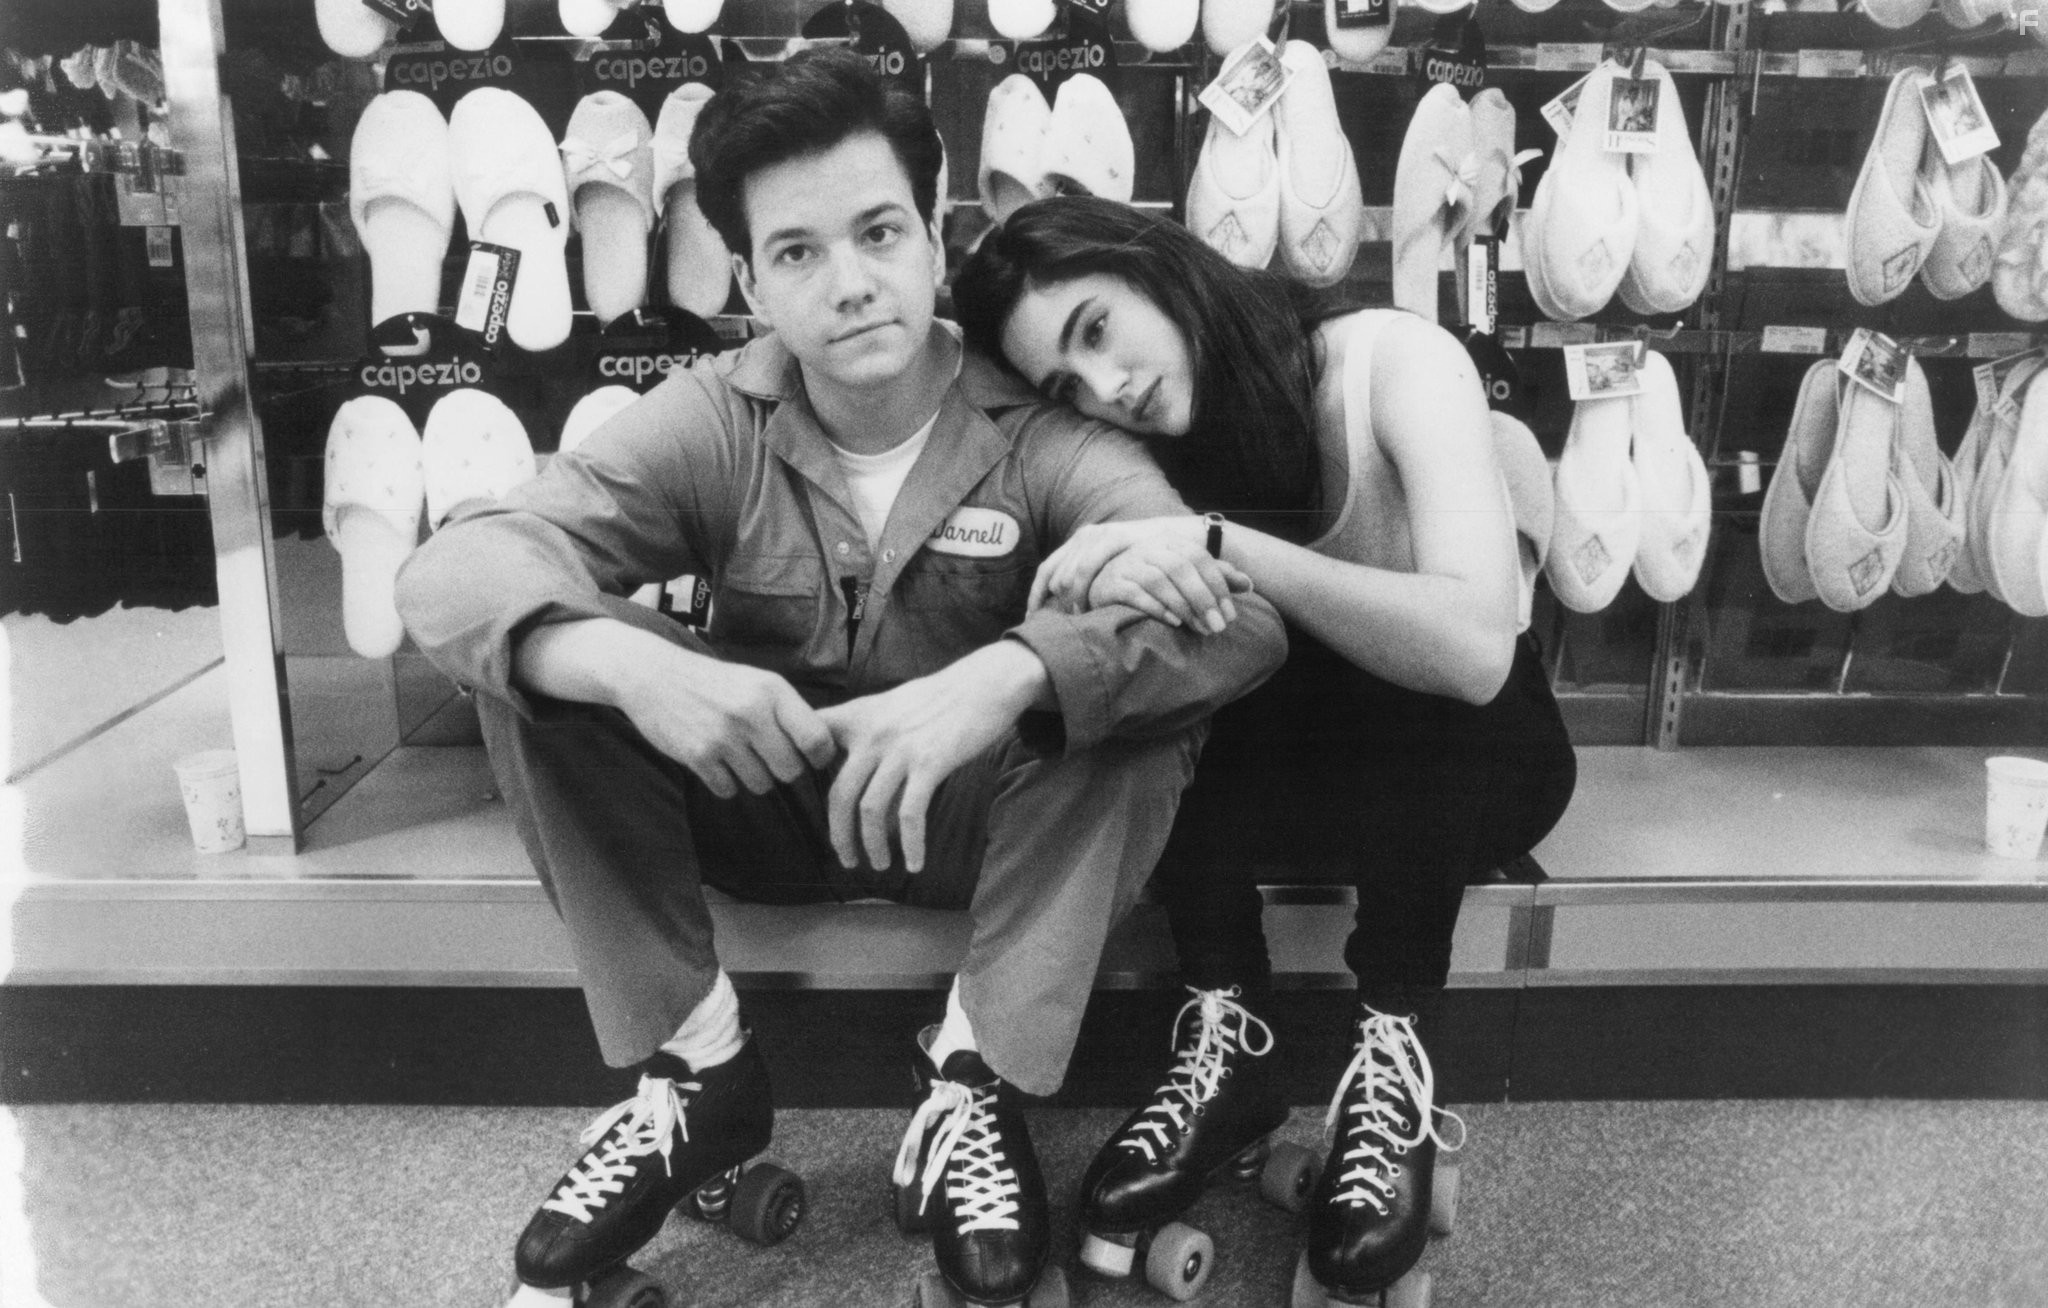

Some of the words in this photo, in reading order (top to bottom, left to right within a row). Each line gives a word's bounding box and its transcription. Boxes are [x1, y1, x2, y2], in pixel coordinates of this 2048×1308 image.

[394, 51, 512, 91] capezio
[595, 49, 707, 88] capezio
[1018, 39, 1104, 81] capezio
[1427, 58, 1483, 87] capezio
[485, 280, 508, 343] capezio
[361, 356, 481, 395] capezio
[599, 347, 717, 384] capezi
